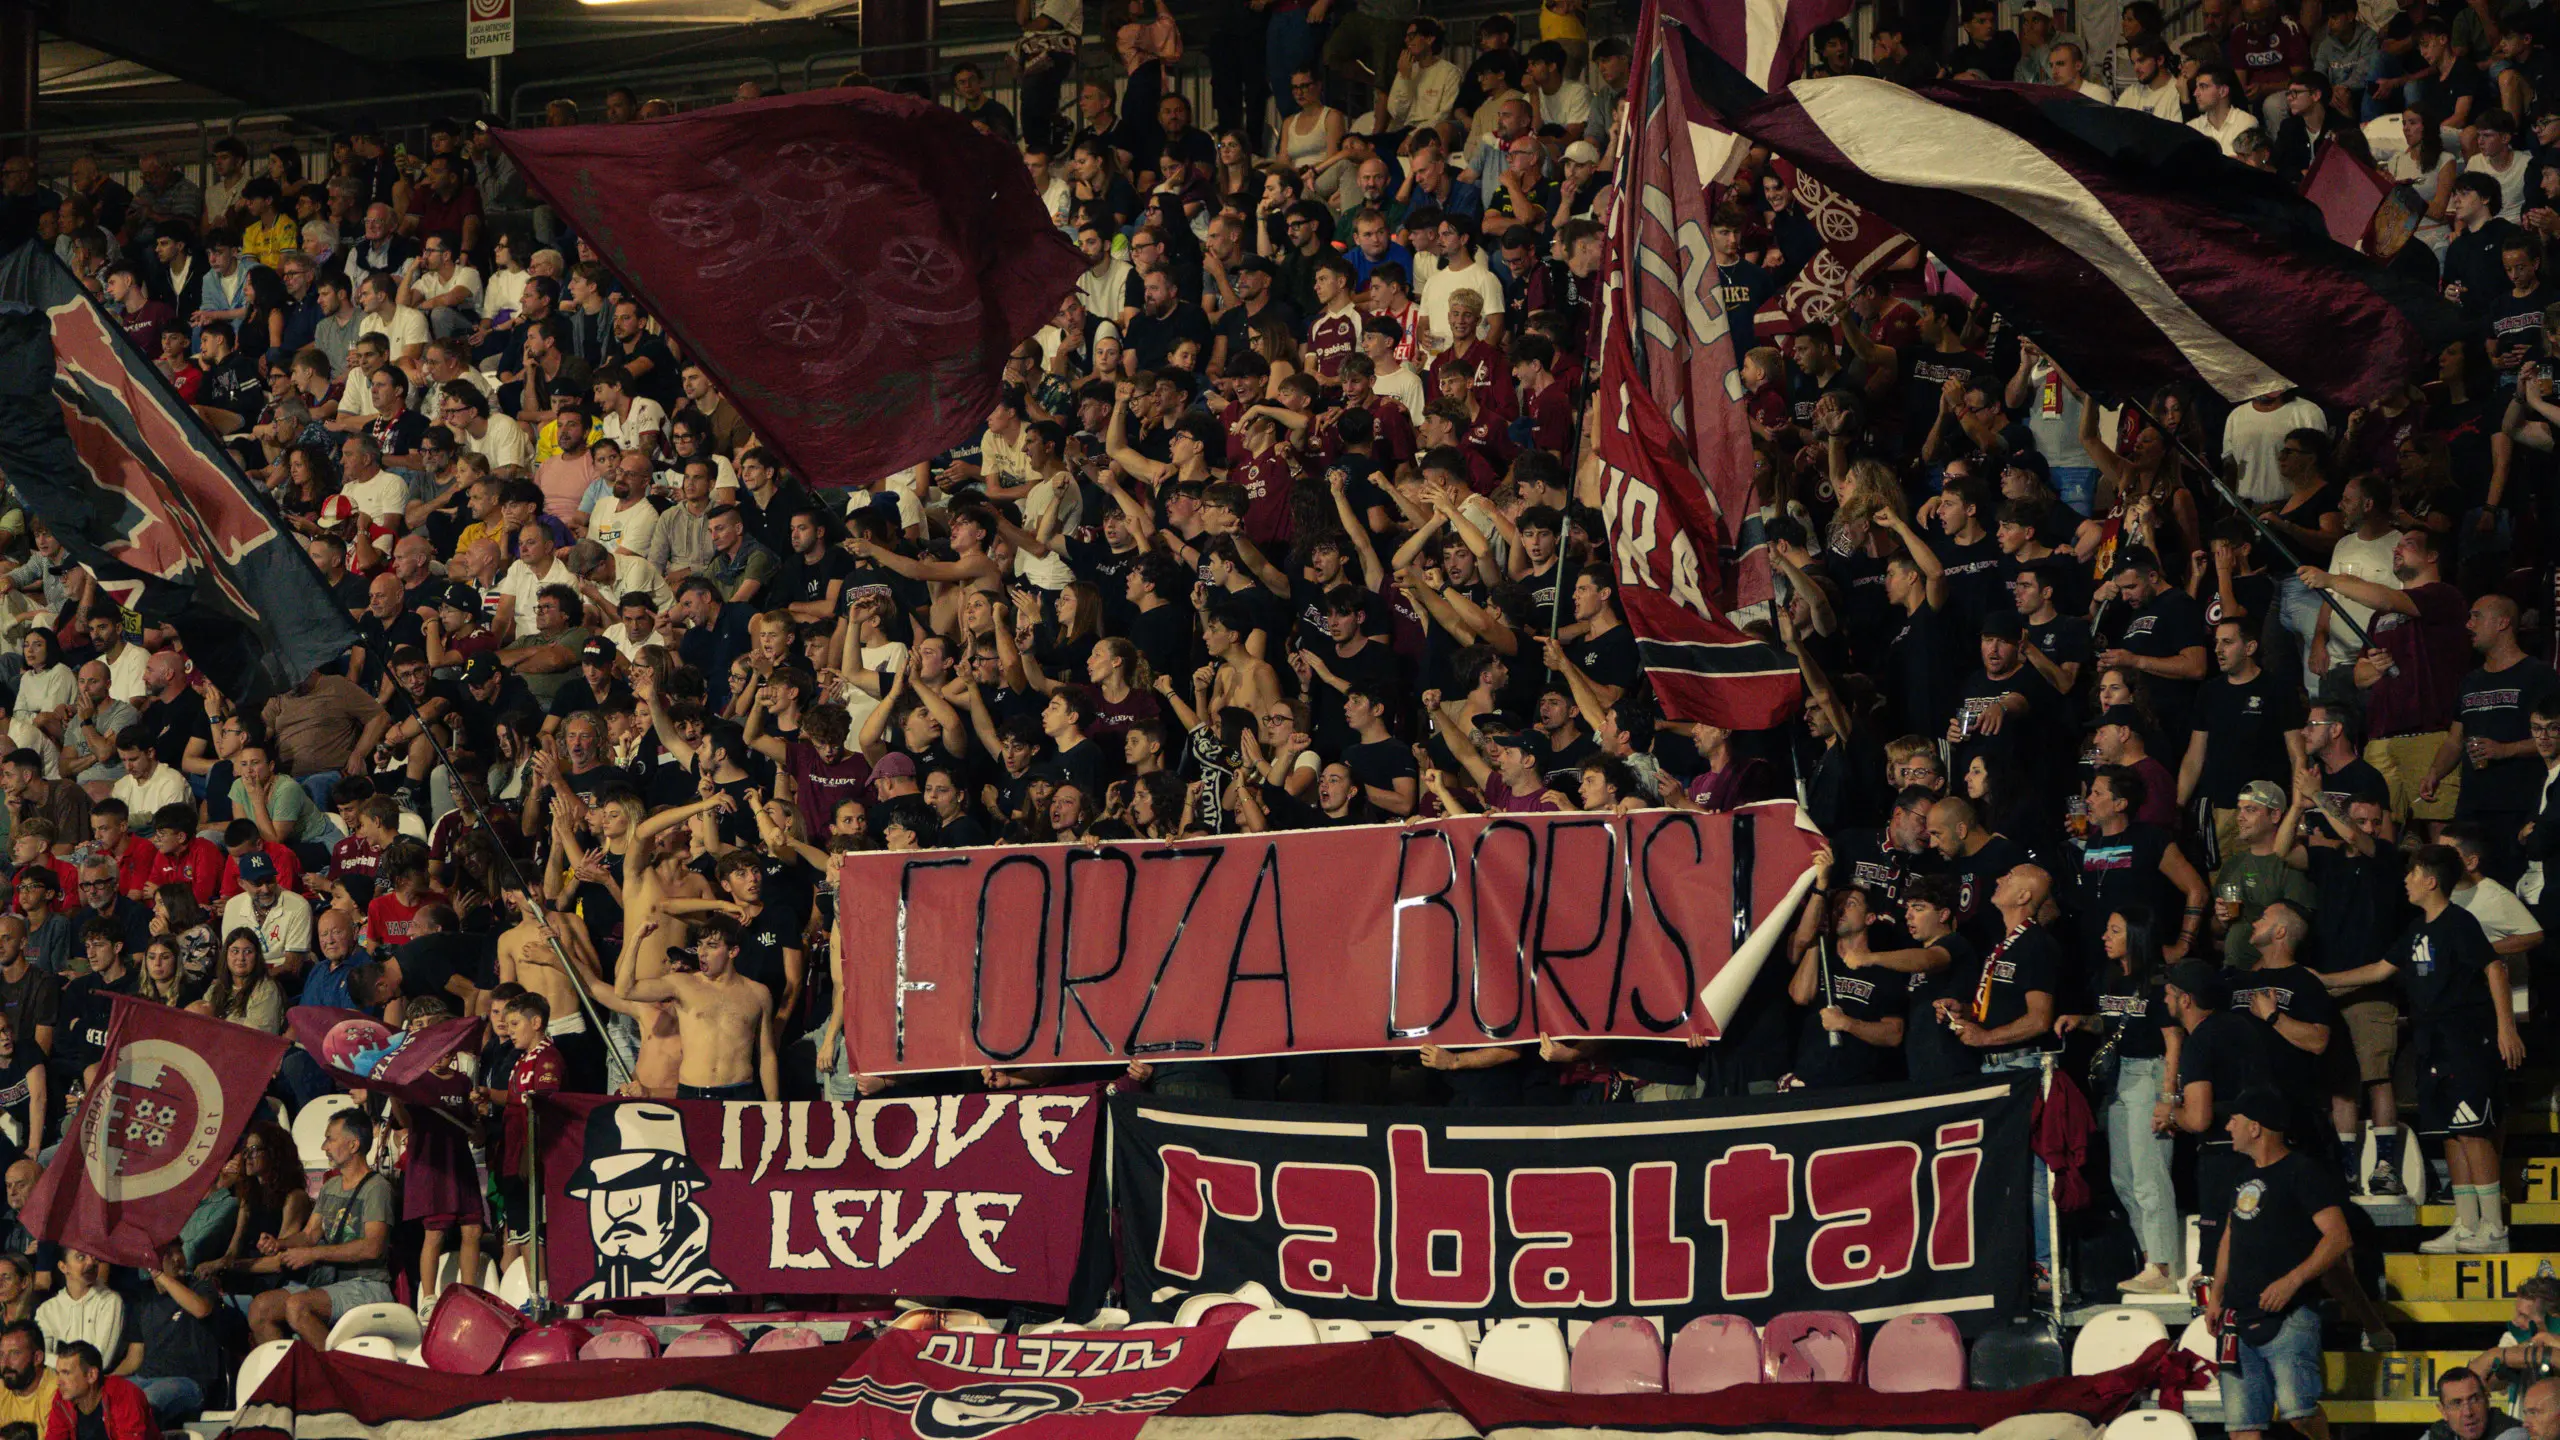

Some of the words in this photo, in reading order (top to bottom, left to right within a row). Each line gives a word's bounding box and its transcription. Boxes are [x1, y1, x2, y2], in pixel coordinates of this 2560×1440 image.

[470, 32, 511, 45] IDRANTE
[1722, 286, 1750, 303] IKE
[896, 842, 1294, 1063] FORZA
[719, 1094, 1090, 1185] NUOVE
[768, 1189, 1023, 1274] LEVE
[1154, 1118, 1984, 1308] rabaltai
[914, 1334, 1183, 1378] POZZETTO
[2382, 1357, 2440, 1398] FIL
